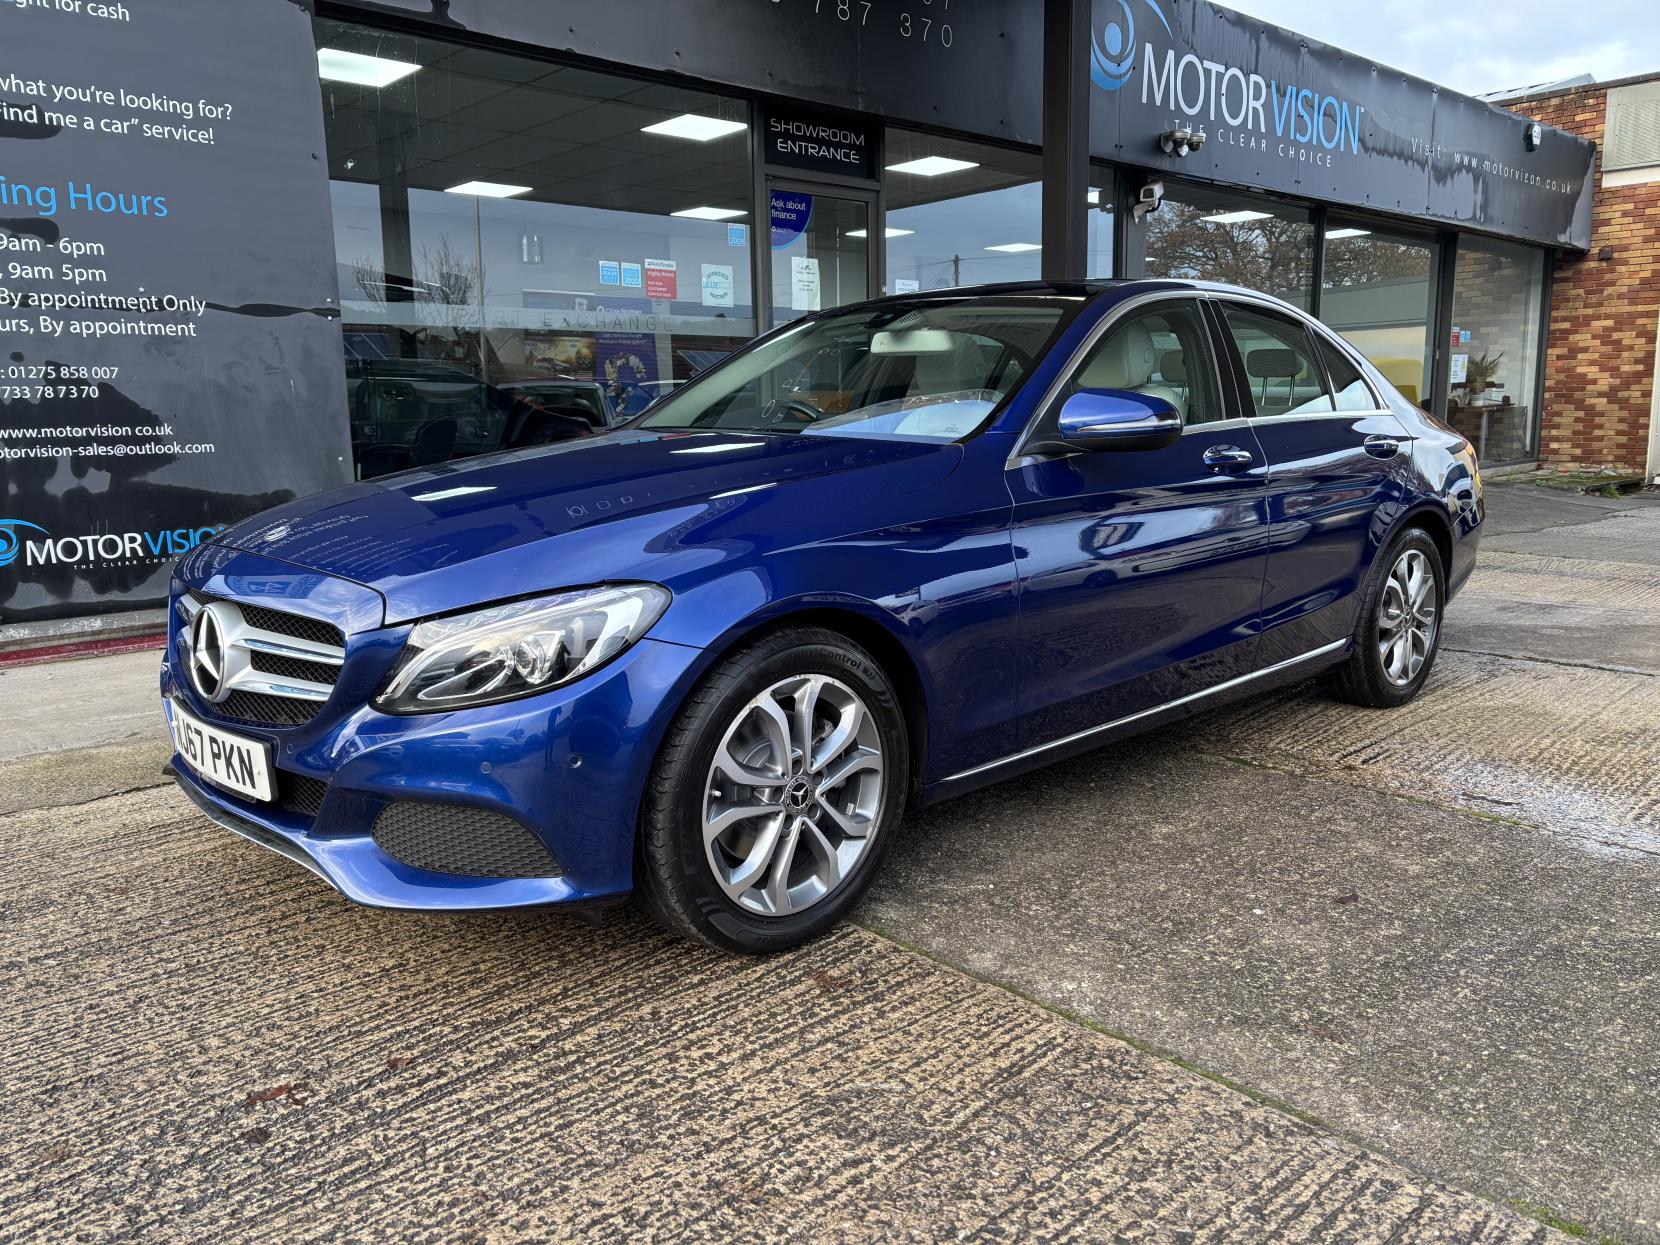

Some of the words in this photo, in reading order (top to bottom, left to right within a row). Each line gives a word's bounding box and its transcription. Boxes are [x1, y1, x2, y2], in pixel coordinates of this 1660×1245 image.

[87, 3, 129, 22] cash
[901, 13, 952, 47] 370
[120, 89, 193, 119] looking
[198, 99, 232, 120] for?
[0, 102, 38, 123] ind
[44, 112, 77, 128] me
[84, 116, 94, 130] a
[143, 123, 215, 145] service!
[770, 118, 865, 146] SHOWROOM
[777, 138, 860, 163] ENTRANCE
[1218, 129, 1266, 151] CLEAR
[1278, 144, 1331, 167] CHOICE
[1411, 136, 1446, 160] Visit:
[68, 182, 168, 217] Hours
[771, 198, 784, 208] Ask
[786, 200, 806, 210] about
[771, 208, 797, 220] finance
[0, 233, 41, 252] 9am
[59, 237, 105, 258] 6pm
[8, 262, 53, 280] 9am
[62, 264, 107, 284] 5pm
[0, 288, 21, 309] By
[28, 291, 158, 310] appointment
[163, 295, 206, 316] Only
[39, 316, 63, 336] By
[70, 319, 197, 338] appointment
[543, 312, 673, 332] EXCHANGE
[8, 366, 56, 379] 01275
[60, 366, 88, 379] 858
[92, 367, 118, 379] 007
[26, 527, 224, 566] MOTORVISIO
[73, 563, 94, 571] THE
[103, 560, 138, 568] CLEAR
[146, 556, 180, 564] CHOIC
[208, 734, 257, 790] PKN
